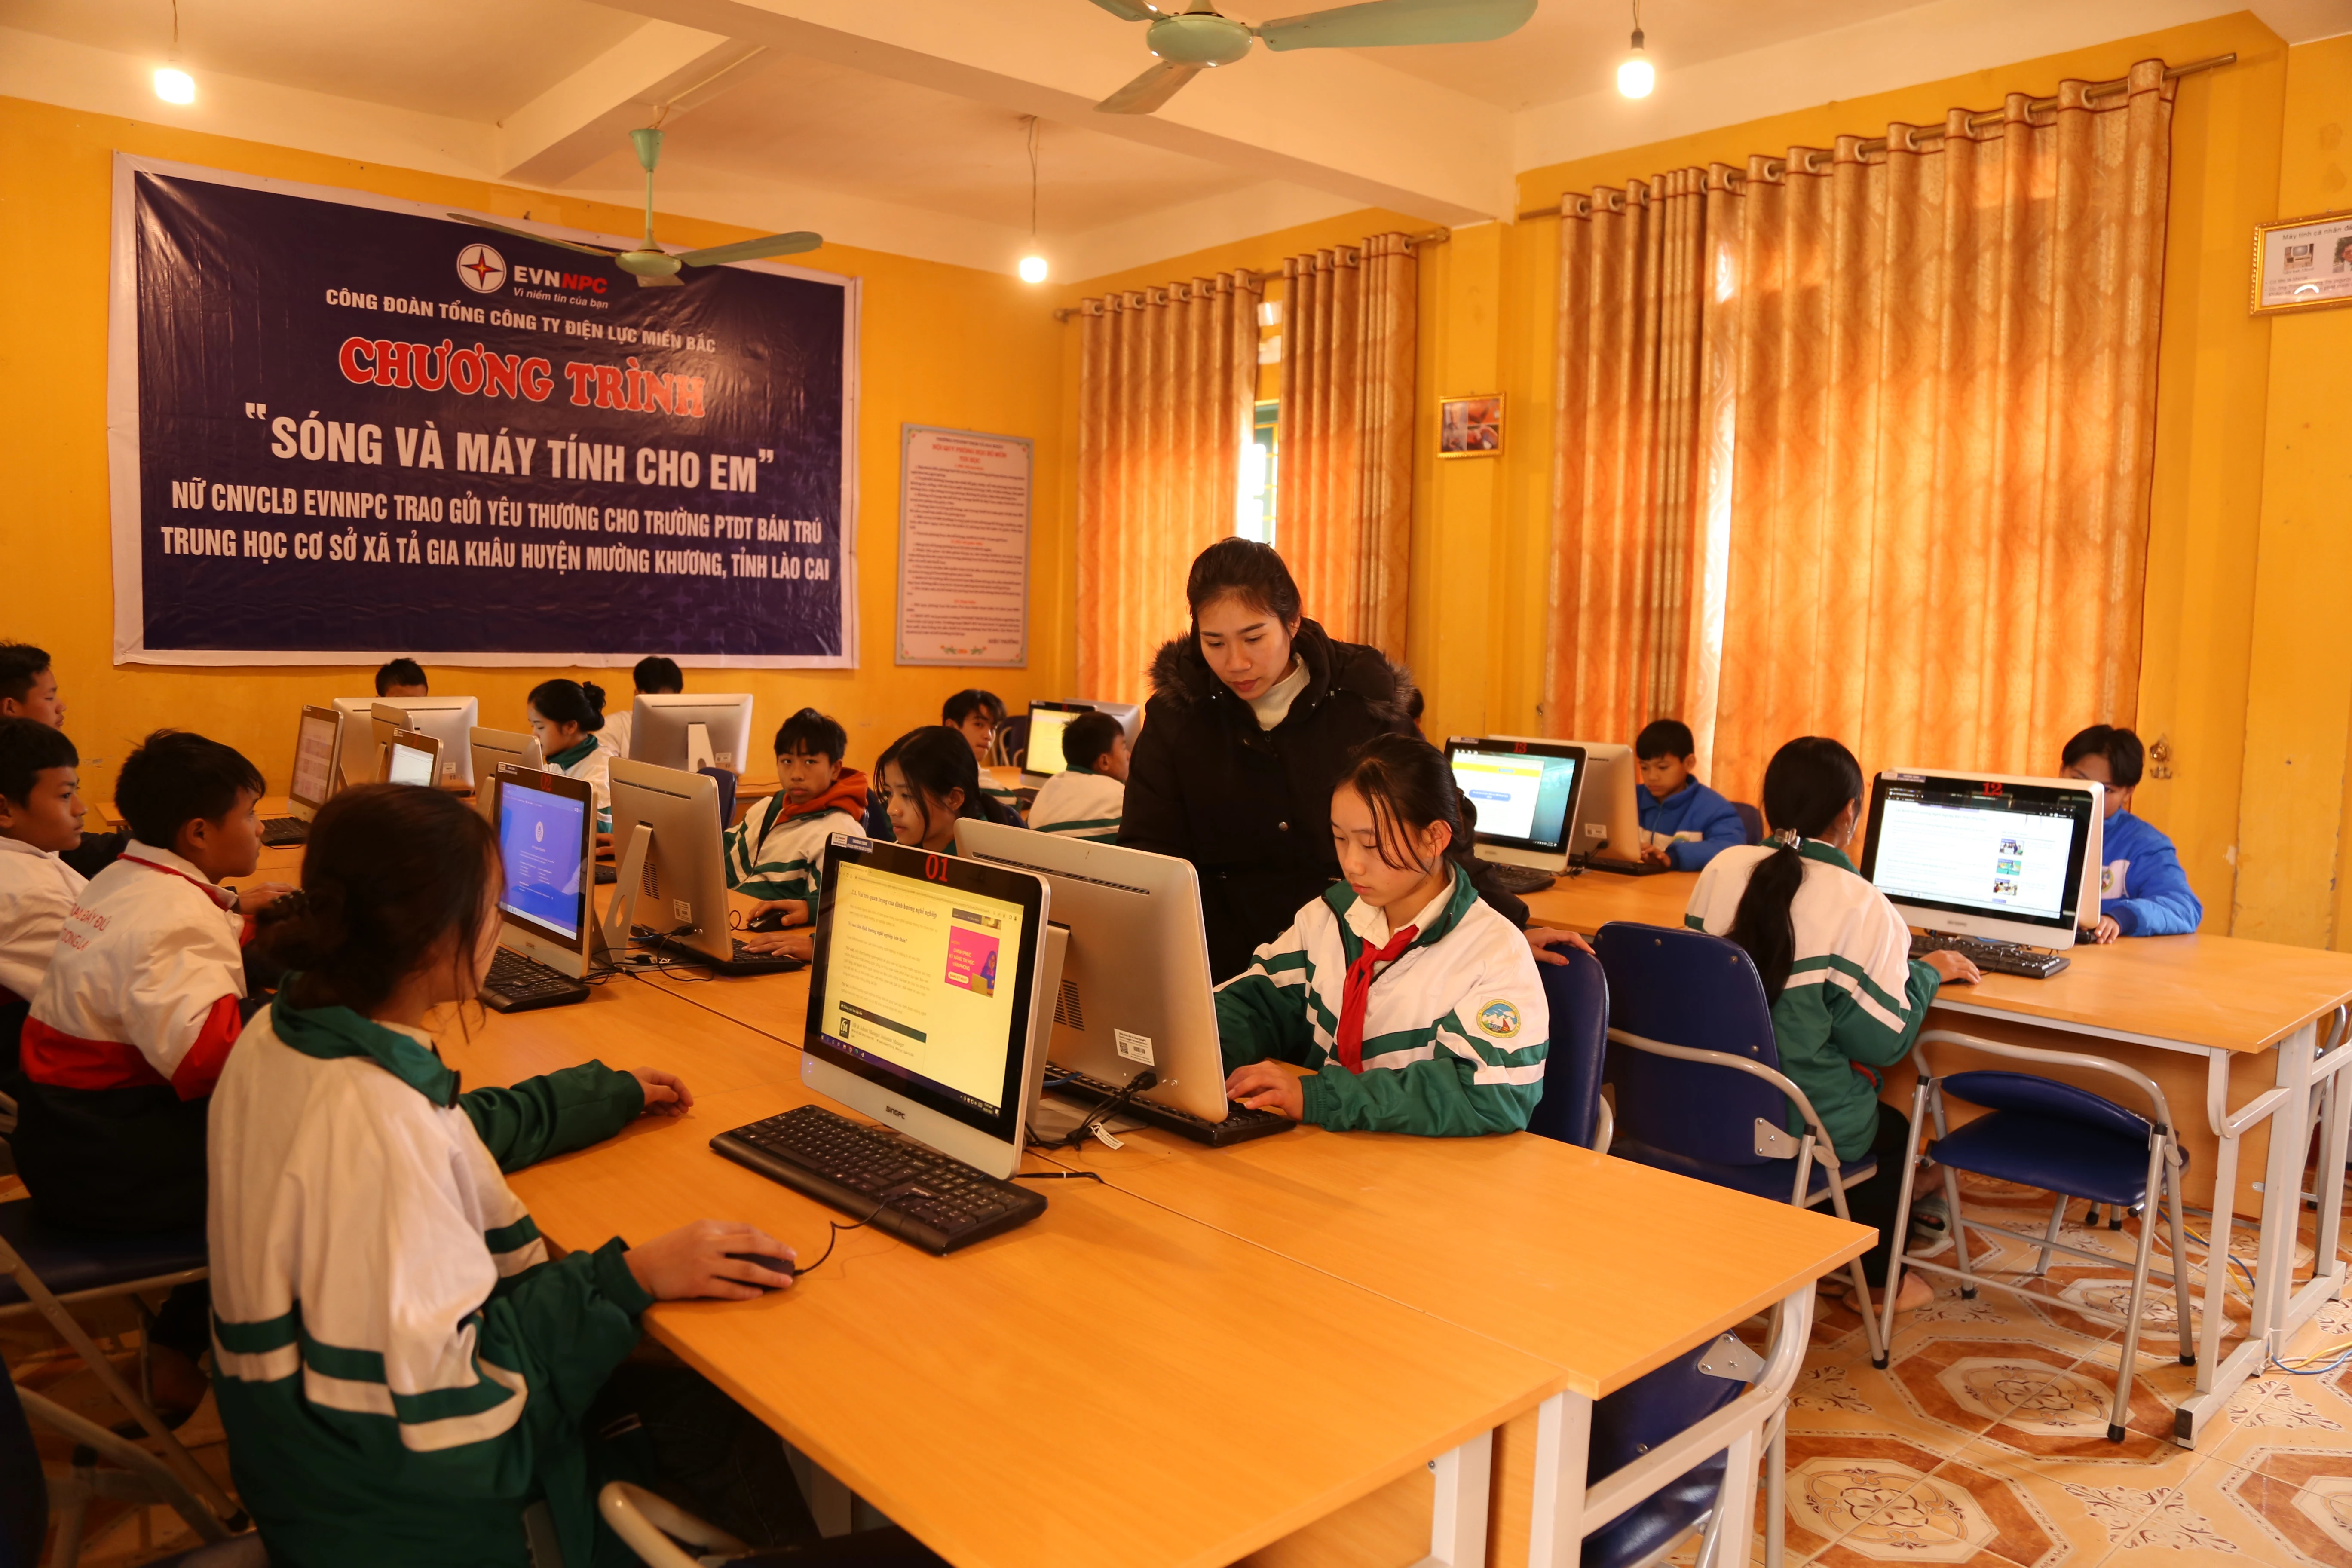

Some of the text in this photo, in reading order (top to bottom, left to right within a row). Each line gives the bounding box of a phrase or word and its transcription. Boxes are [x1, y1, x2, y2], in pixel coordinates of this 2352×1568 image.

[514, 265, 608, 294] EVNNPC
[514, 287, 609, 310] Vì niềm tin của bạn
[326, 288, 716, 353] CÔNG ĐOÀN TỔNG CÔNG TY ĐIỆN LỰC MIỀN BẮC
[339, 337, 706, 418] CHƯƠNG TRÌNH
[395, 420, 444, 469] VÀ
[457, 426, 536, 476] MÁY
[547, 433, 625, 483] TÍNH
[636, 447, 700, 489] CHO
[172, 477, 822, 544] NỮ CNVCLĐ EVNNPC TRAO GỬI YÊU THƯƠNG CHO TRƯỜNG PTDT BÁN TRÚ
[161, 526, 829, 581] TRUNG HỌC CƠ SỞ XÃ TẢ GIA KHÂU HUYỆN MƯỜNG KHƯƠNG, TỈNH LÀO CAI
[1513, 742, 1527, 753] 13
[541, 773, 552, 792] 02
[1981, 782, 2003, 796] 12
[925, 854, 948, 882] 01
